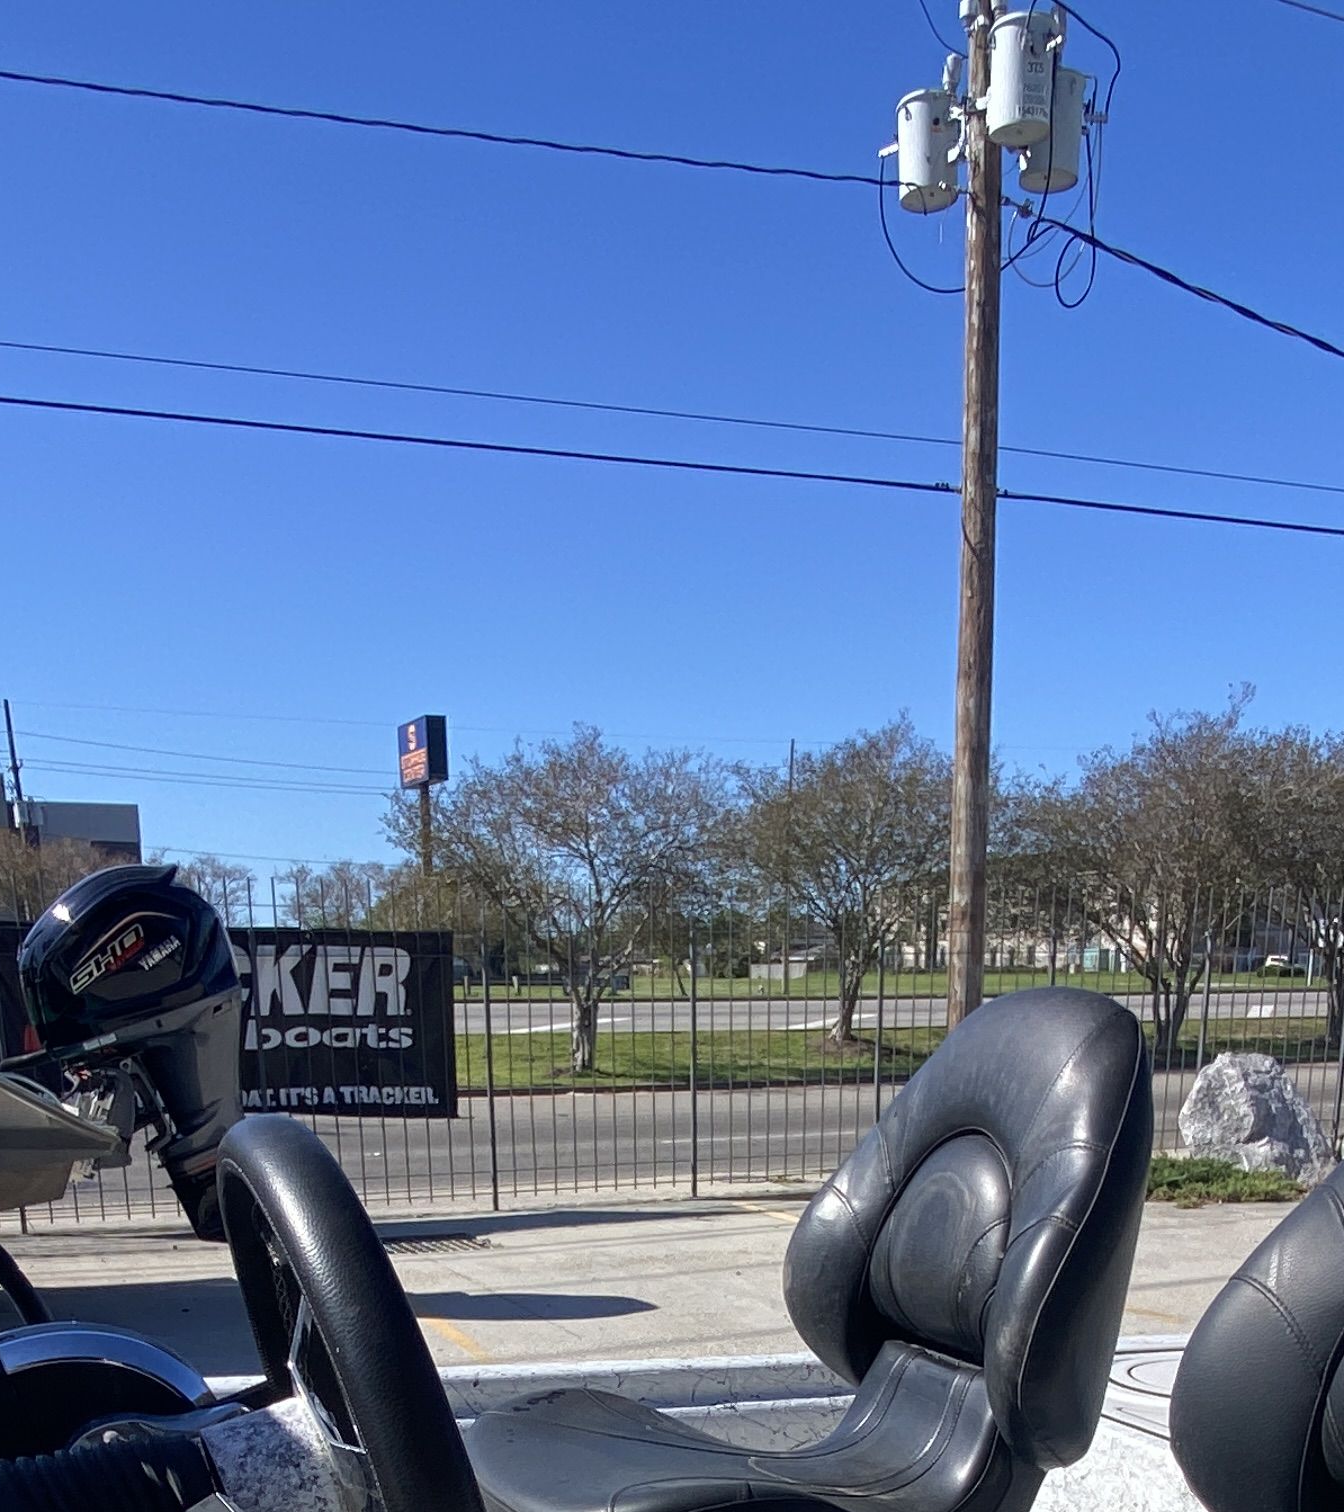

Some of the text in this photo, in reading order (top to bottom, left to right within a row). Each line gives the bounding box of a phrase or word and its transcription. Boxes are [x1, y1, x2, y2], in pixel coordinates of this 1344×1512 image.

[69, 923, 145, 995] SHO
[138, 934, 182, 972] YAMAHA
[244, 1019, 414, 1050] boats
[322, 1086, 338, 1105] A
